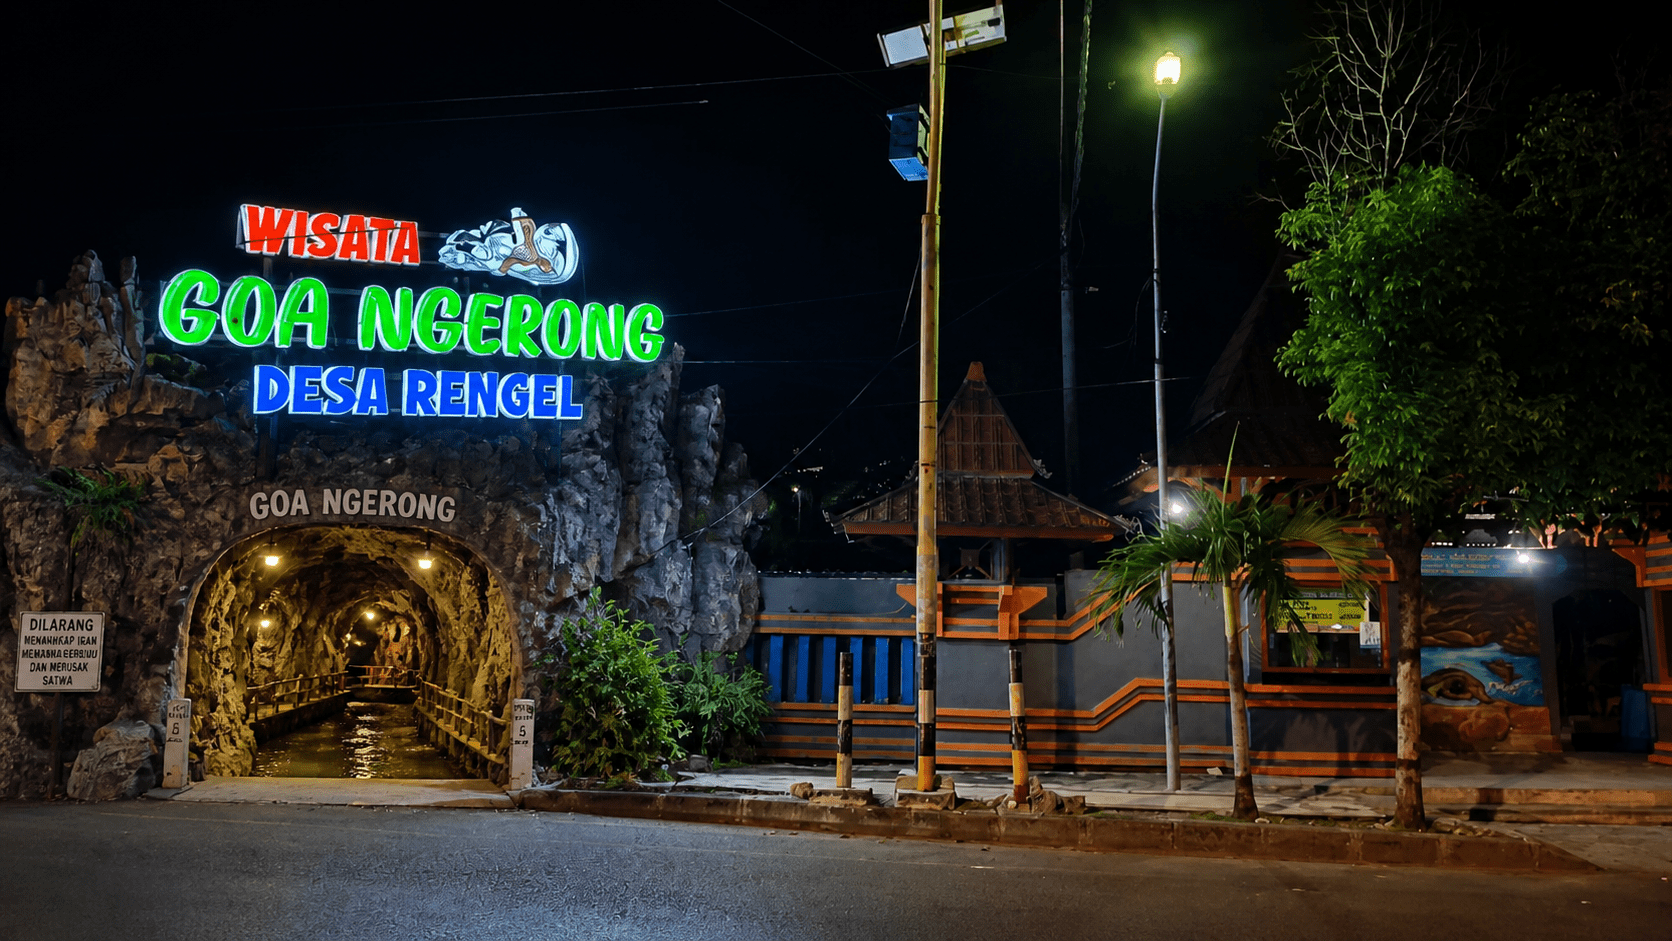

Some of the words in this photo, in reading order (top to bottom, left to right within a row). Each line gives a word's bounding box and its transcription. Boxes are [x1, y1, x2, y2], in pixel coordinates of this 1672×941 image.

[239, 203, 420, 266] WISATA
[158, 268, 330, 348] GOA
[357, 285, 665, 363] NGERONG
[253, 364, 389, 416] DESA
[401, 368, 584, 420] RENGEL
[249, 489, 310, 520] GOA
[322, 488, 456, 522] NGERONG
[29, 618, 94, 631] DILARANG
[29, 661, 47, 673] DAN
[42, 675, 73, 686] SATWA
